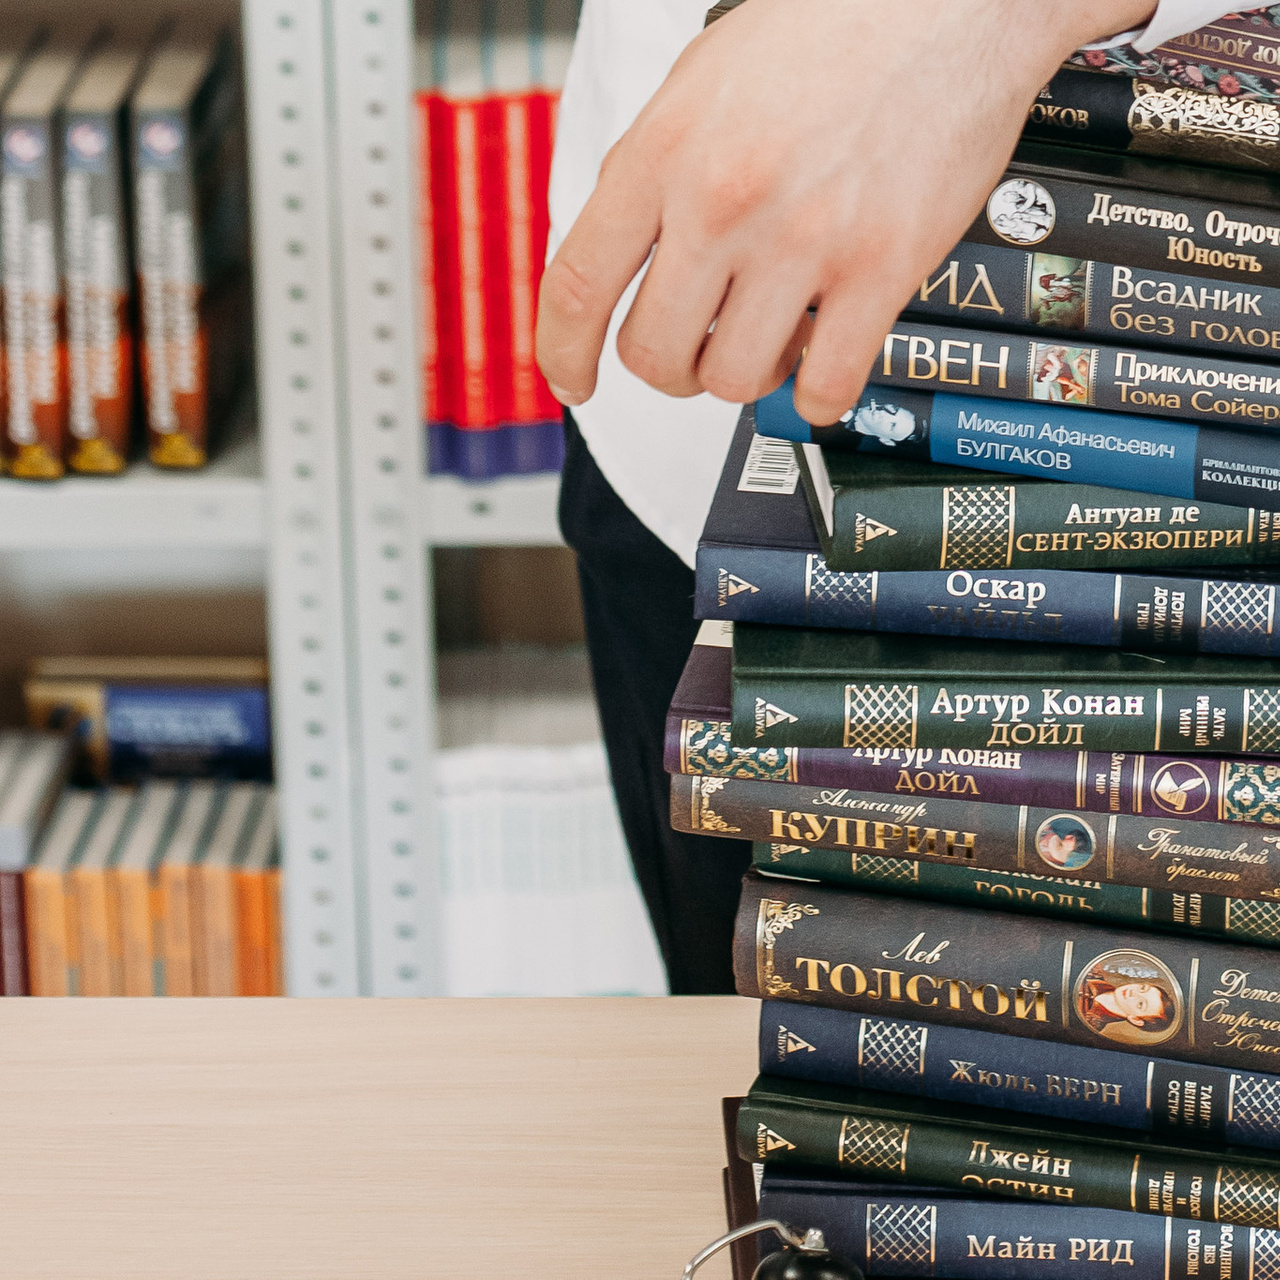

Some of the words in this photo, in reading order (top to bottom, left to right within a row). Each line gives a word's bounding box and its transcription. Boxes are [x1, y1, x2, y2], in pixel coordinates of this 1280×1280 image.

[1087, 193, 1195, 233] Детство.
[1166, 236, 1263, 273] Юность
[920, 260, 1005, 315] ИД
[1111, 266, 1263, 316] Всадник
[1109, 303, 1175, 336] без
[1114, 381, 1182, 410] Тома
[957, 410, 1035, 440] Михаил
[1037, 420, 1176, 459] Афанасьевич
[956, 438, 1072, 471] БУЛГАКОВ
[1064, 503, 1161, 529] Антуан
[1169, 506, 1200, 525] де
[1015, 529, 1245, 553] СЕНТ-ЭКЗЮПЕРИ
[945, 570, 1046, 609] Оскар
[930, 688, 1030, 722] Артур
[1040, 689, 1144, 717] Конан
[986, 717, 1085, 747] ДОЙЛ
[1179, 708, 1192, 737] МИР
[895, 770, 981, 795] ДОЙЛ
[1095, 773, 1107, 795] МИР
[1109, 753, 1126, 811] ЗАТЕРЯННЫЙ
[812, 789, 928, 824] Александр
[768, 808, 978, 861] КУПРИН
[1137, 827, 1270, 865] Гранатовый
[1165, 858, 1242, 883] браслет
[882, 931, 950, 965] Лев
[795, 956, 1051, 1023] ТОЛСТОЙ
[948, 1058, 1038, 1093] Жюль
[966, 1140, 1073, 1178] Джейн
[966, 1234, 1057, 1261] Майн
[1067, 1237, 1135, 1266] РИД
[1187, 1228, 1201, 1276] ГОЛОВЫ
[1203, 1244, 1217, 1265] БЕЗ
